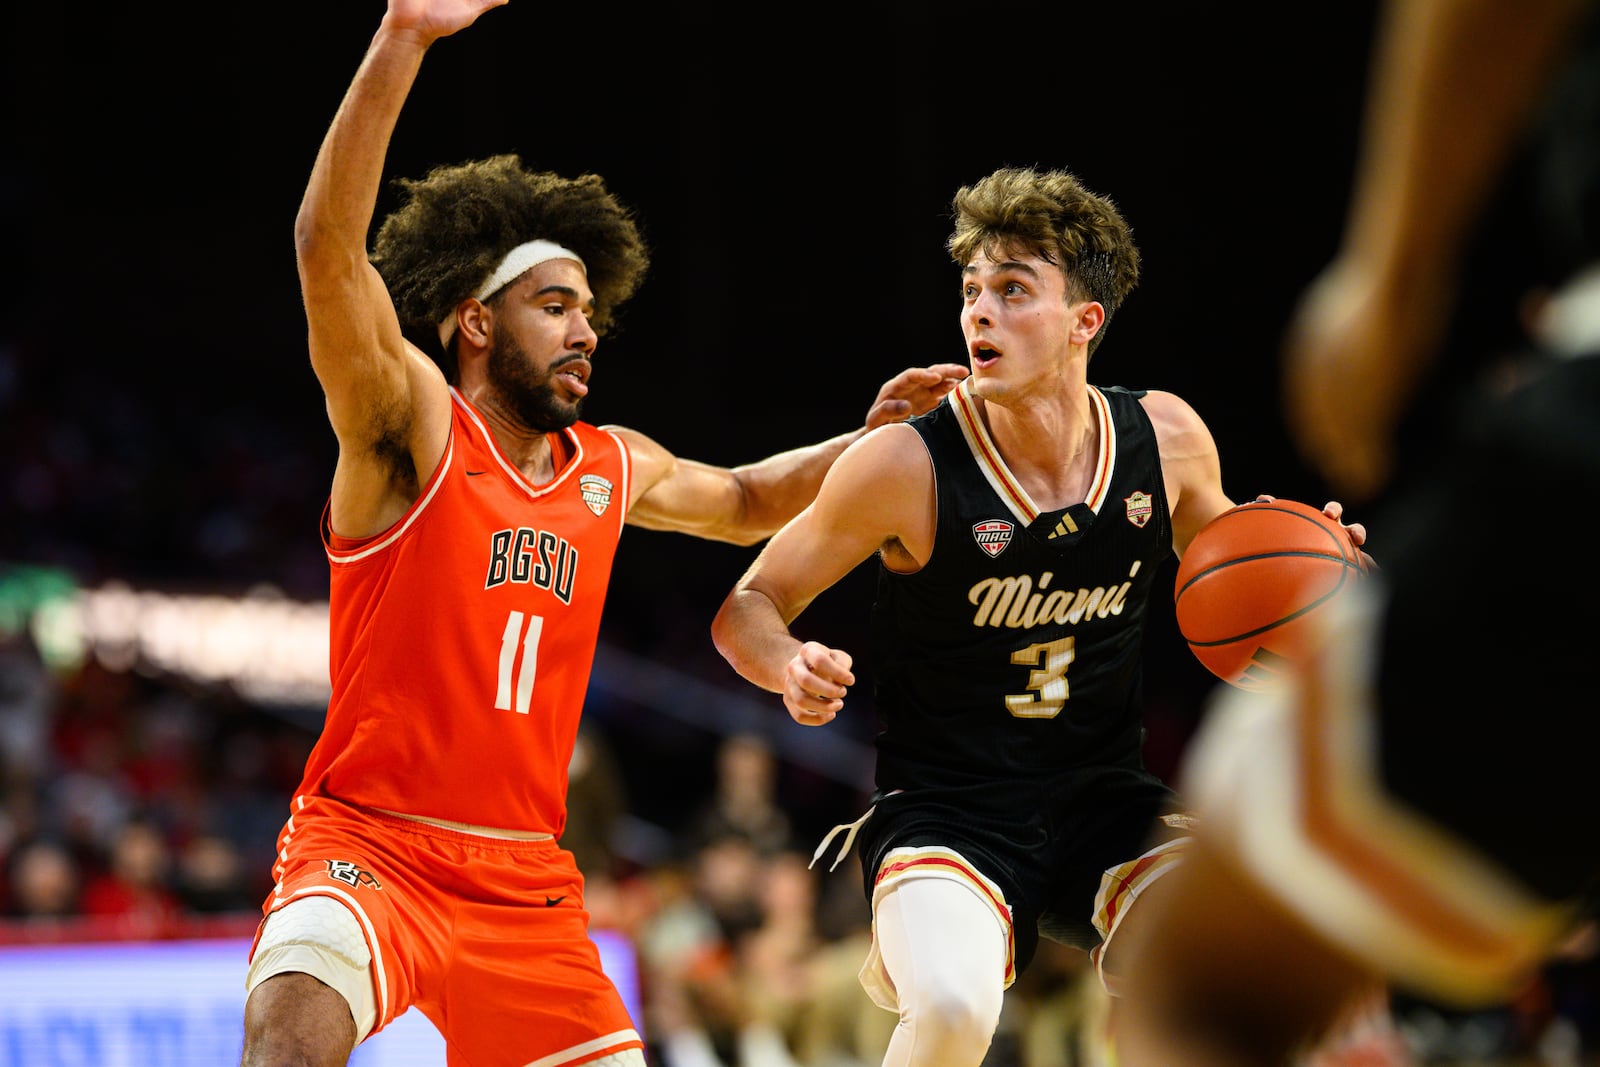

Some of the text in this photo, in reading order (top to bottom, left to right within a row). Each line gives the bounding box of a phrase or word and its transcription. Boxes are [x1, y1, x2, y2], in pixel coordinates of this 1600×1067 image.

[583, 491, 610, 505] MAC
[485, 527, 578, 606] BGSU
[977, 532, 1011, 542] MAC
[968, 560, 1141, 629] Miami
[494, 610, 543, 714] 11
[1005, 635, 1075, 719] 3
